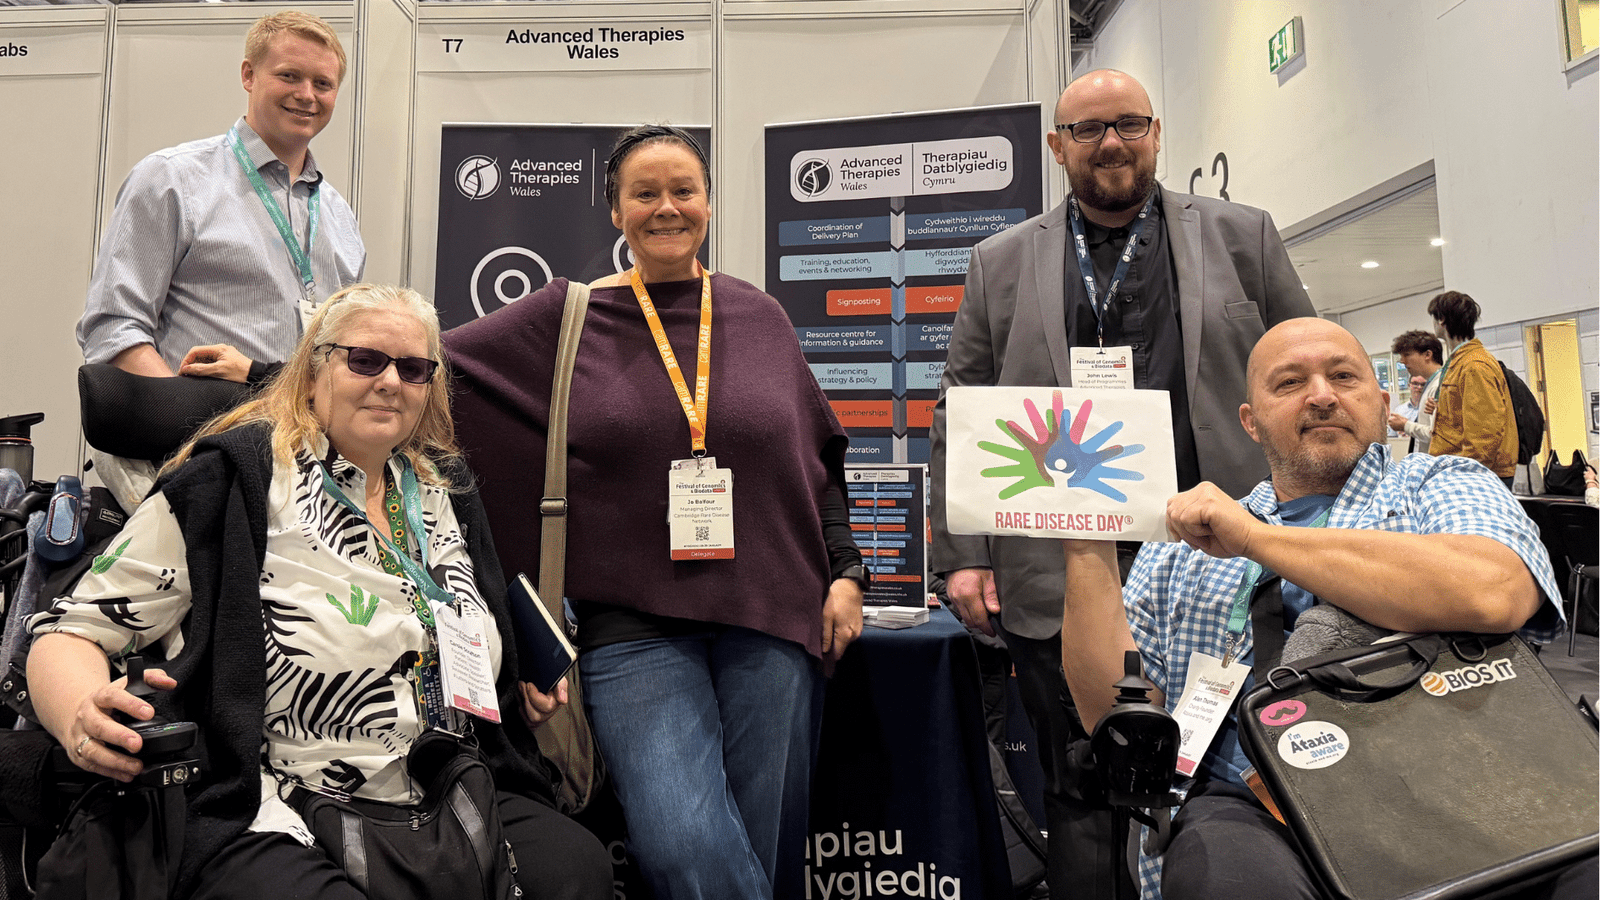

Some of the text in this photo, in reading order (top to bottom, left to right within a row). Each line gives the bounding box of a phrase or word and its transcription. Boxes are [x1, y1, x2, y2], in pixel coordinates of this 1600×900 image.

[505, 27, 685, 45] Advanced Therapies
[0, 42, 28, 57] abs
[442, 38, 464, 53] T7
[567, 44, 619, 59] Wales
[840, 154, 903, 170] Advanced
[922, 149, 988, 165] Therapiau
[509, 158, 582, 171] Advanced
[922, 159, 1008, 176] Datblygiedig
[510, 171, 580, 186] Therapies
[840, 166, 901, 181] Therapies
[840, 181, 868, 192] Wales
[922, 176, 956, 188] Cymru
[509, 186, 541, 197] Wales
[807, 222, 864, 232] Coordination of
[924, 217, 967, 228] Cydweithio
[972, 215, 1006, 223] wireddu
[812, 231, 859, 241] Delivery Plan
[800, 257, 871, 268] Training, education,
[799, 267, 822, 275] events
[830, 265, 872, 275] networking
[837, 297, 881, 307] Signposting
[925, 295, 954, 304] Cyfeirio
[841, 330, 865, 338] centre
[865, 329, 876, 337] for
[849, 338, 884, 347] guidance
[827, 368, 868, 376] Influencing
[817, 377, 848, 385] strategy
[855, 376, 878, 385] policy
[841, 409, 888, 418] partnerships
[995, 511, 1031, 529] RARE
[1034, 512, 1093, 531] DISEASE
[1445, 661, 1513, 688] BIOS IT
[1287, 732, 1301, 741] I'm
[1290, 731, 1337, 754] Ataxia
[1309, 742, 1345, 759] aware
